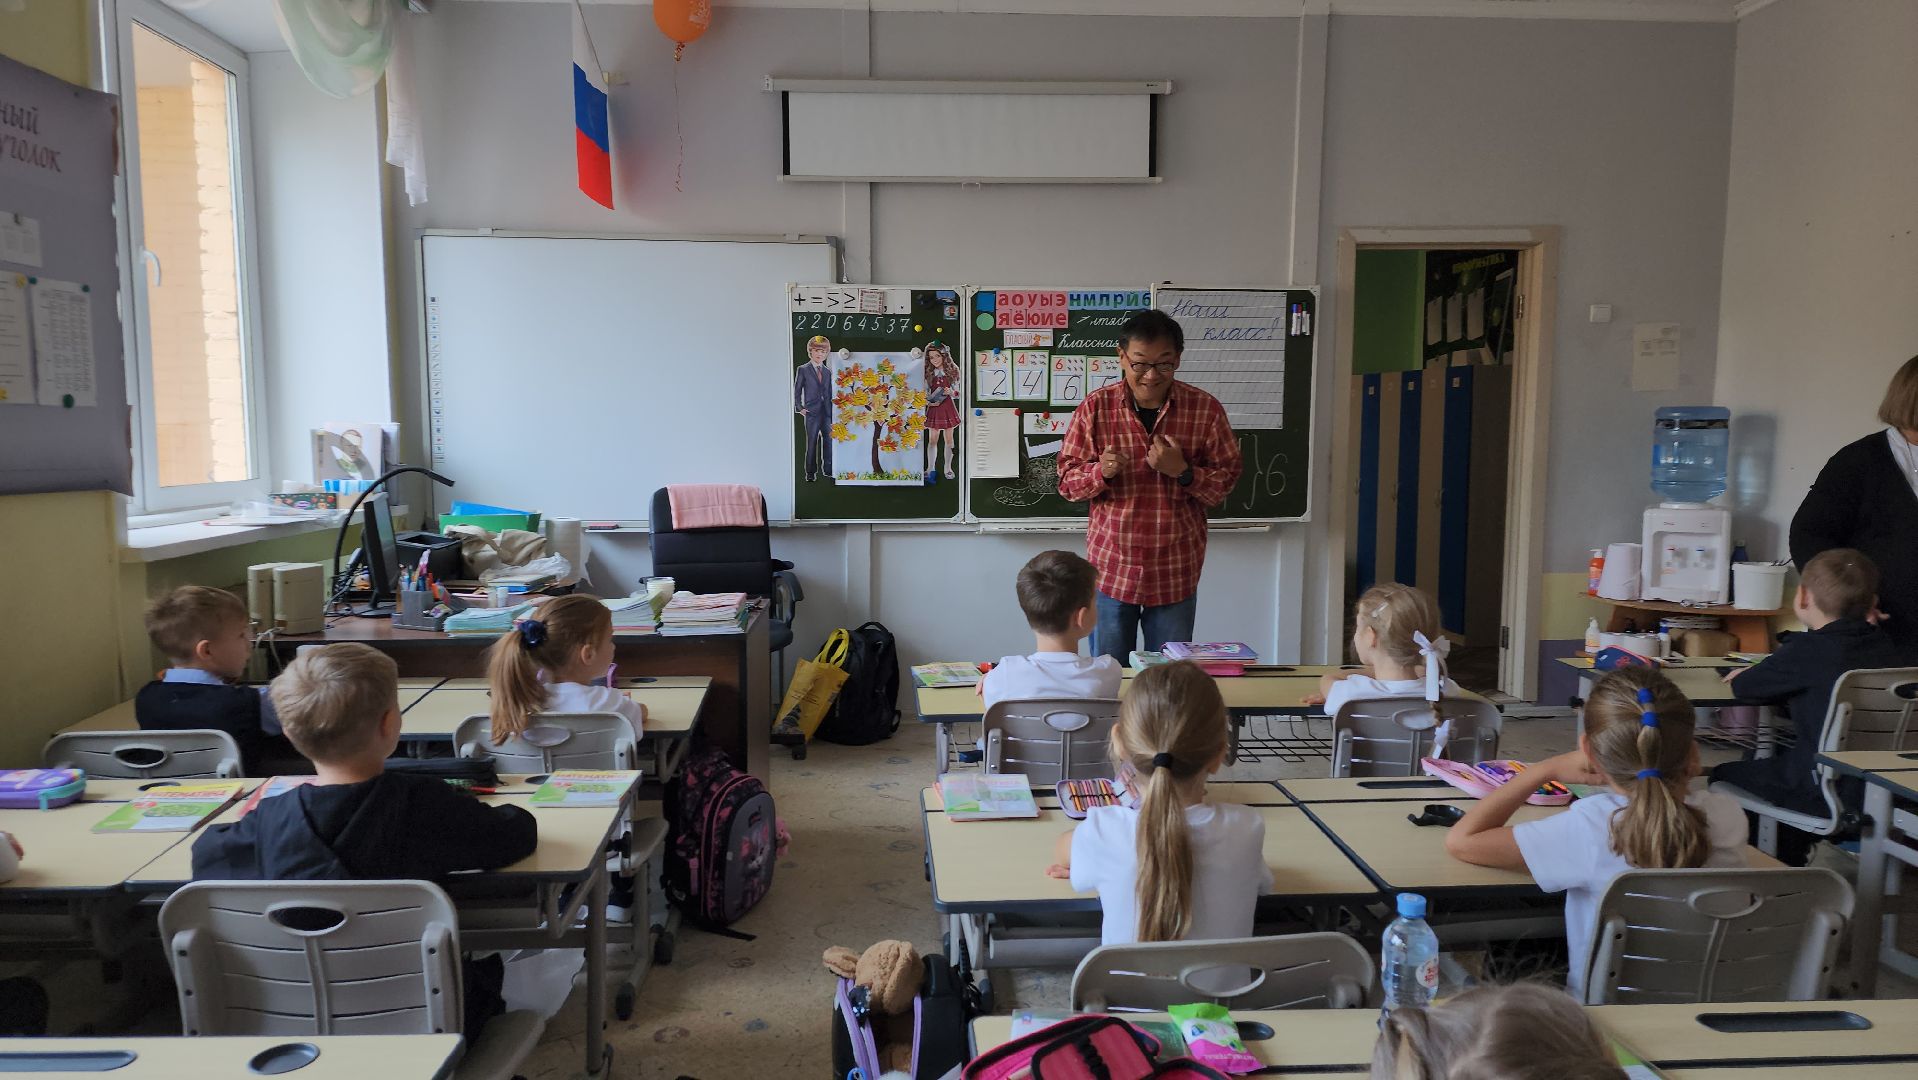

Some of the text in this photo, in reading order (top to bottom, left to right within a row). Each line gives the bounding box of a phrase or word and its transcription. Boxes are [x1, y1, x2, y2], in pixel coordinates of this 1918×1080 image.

[1169, 298, 1230, 319] Наш
[980, 353, 988, 365] 2
[1017, 353, 1025, 364] 4
[1055, 358, 1064, 370] 6
[991, 370, 1007, 396] 2
[1022, 370, 1043, 396] 4
[1063, 375, 1081, 400] 6
